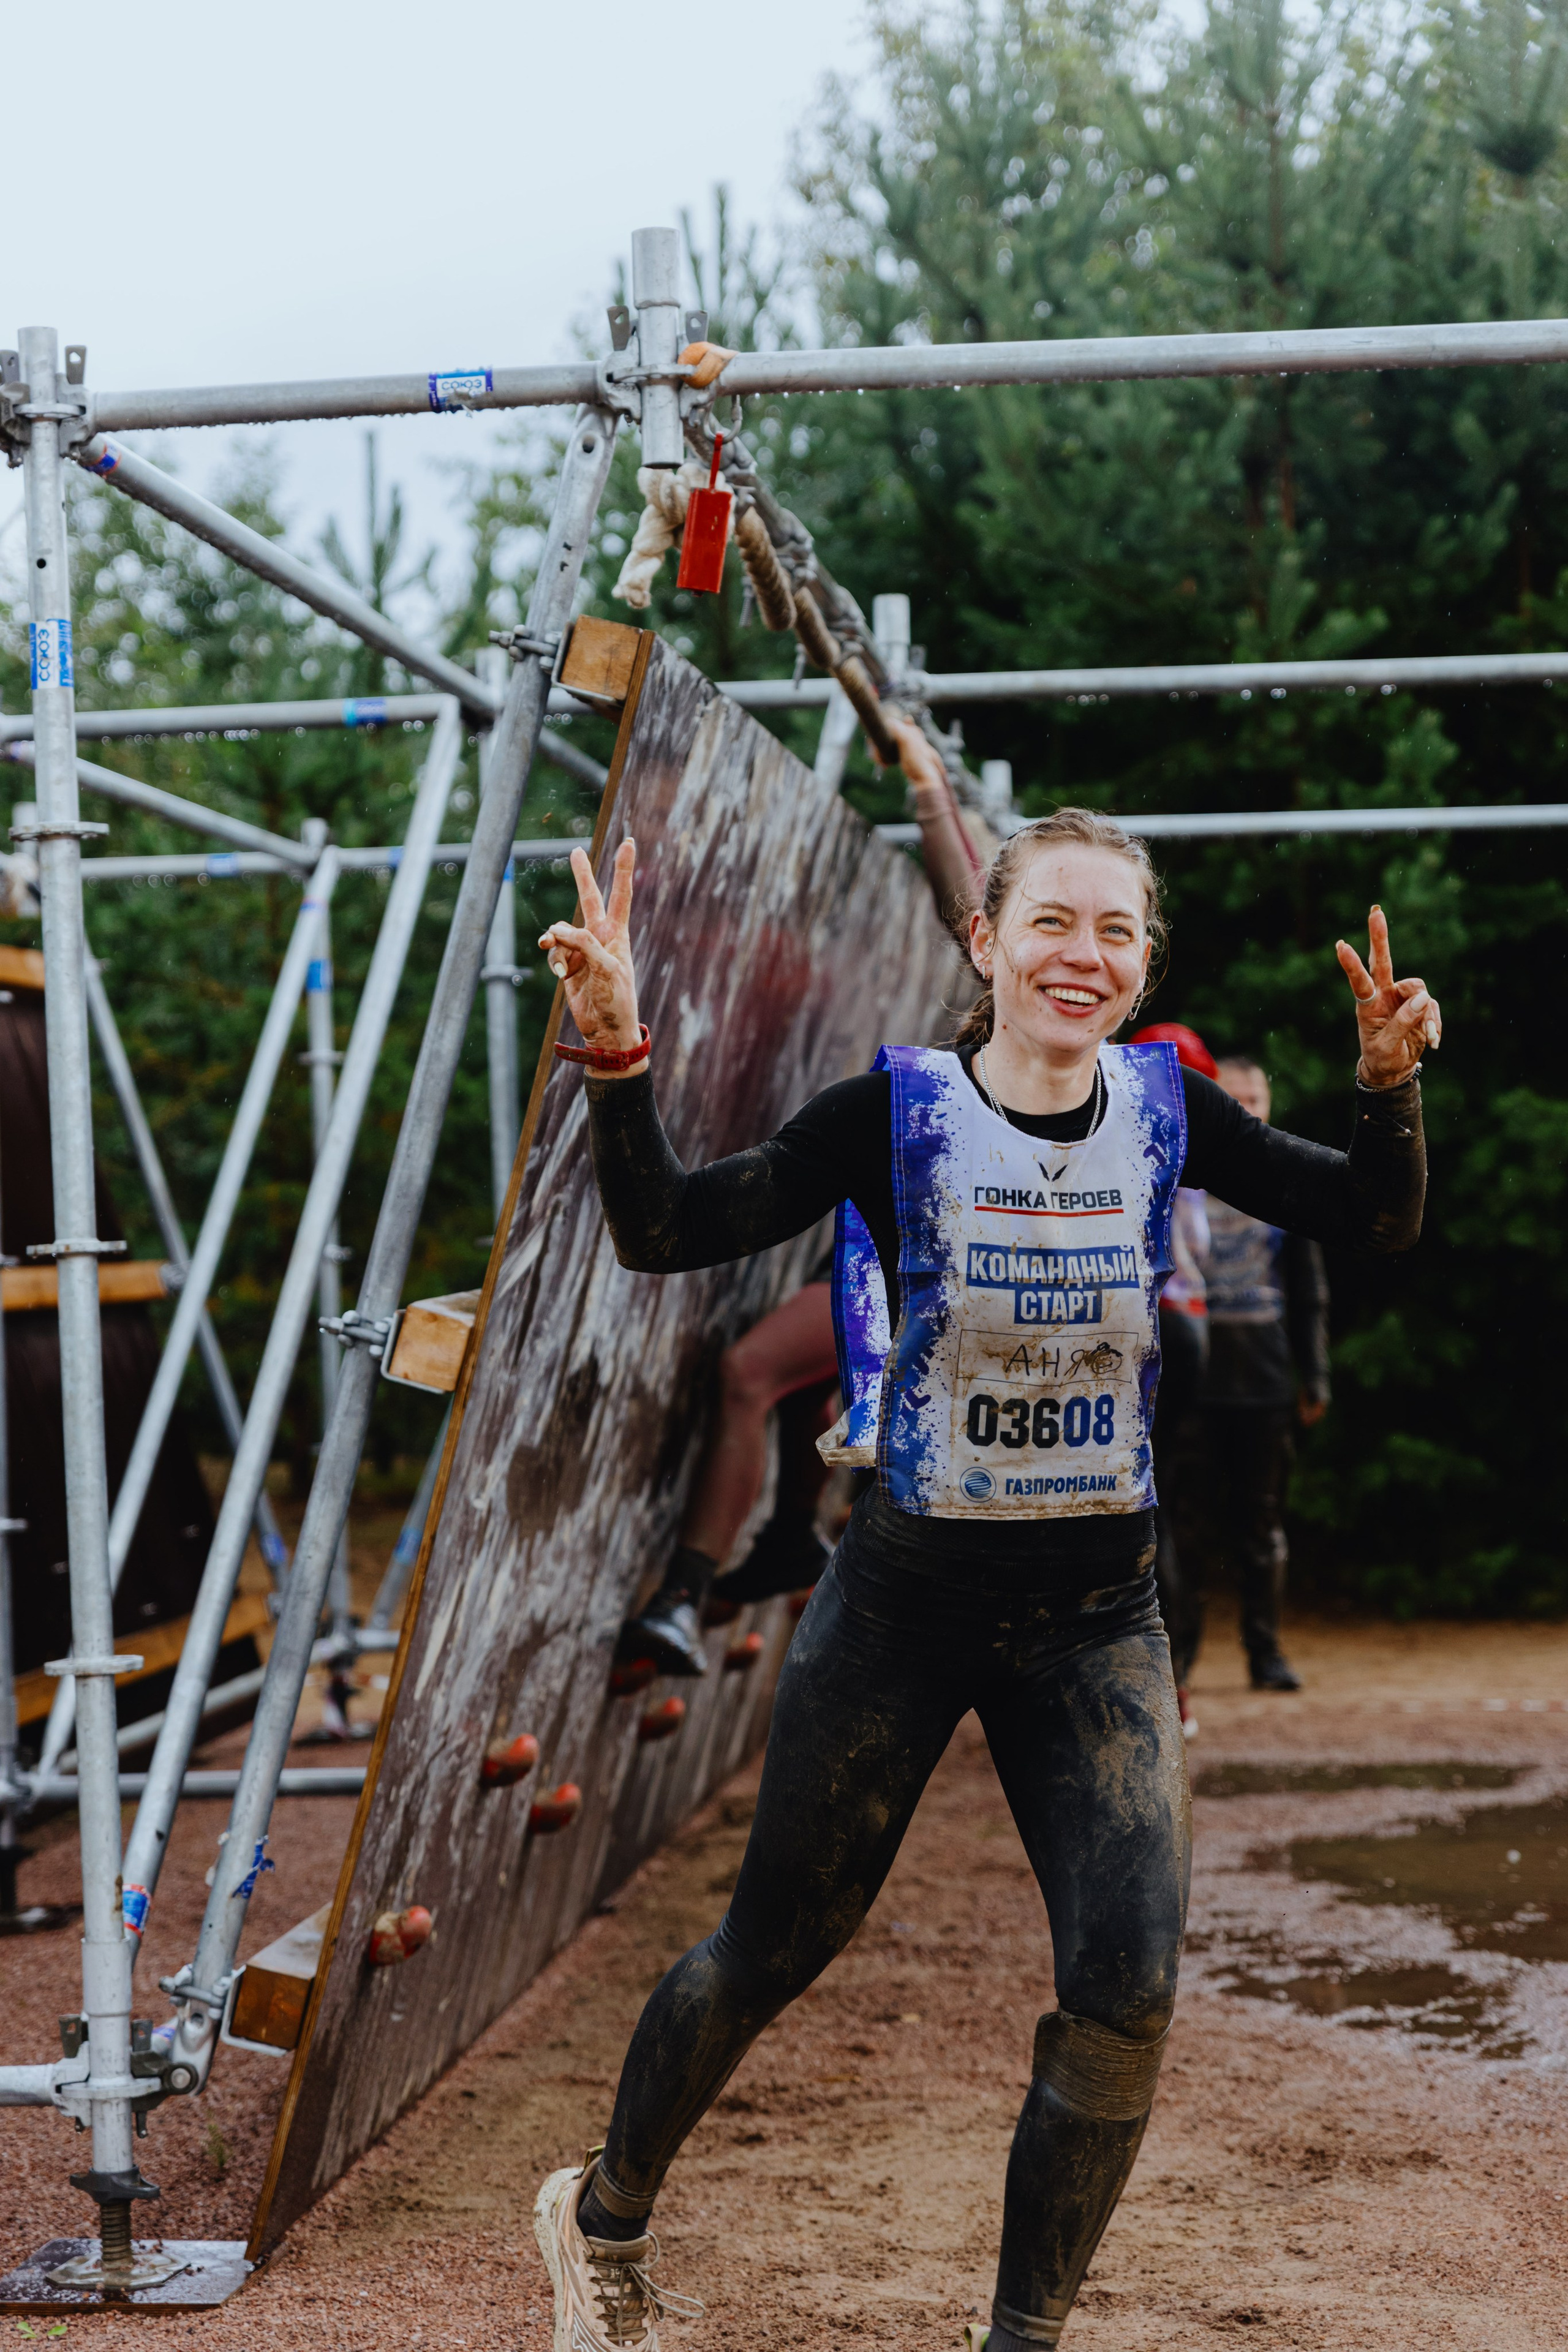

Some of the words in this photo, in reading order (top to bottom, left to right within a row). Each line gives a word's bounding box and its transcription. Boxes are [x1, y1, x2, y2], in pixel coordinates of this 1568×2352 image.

[442, 379, 483, 391] СОЮЗ
[38, 628, 50, 682] СОЮЗ
[974, 1186, 1047, 1209] ГОНКА
[1050, 1189, 1123, 1210] ГЕРОЕВ
[970, 1245, 1136, 1289] КОМАНДНЫЙ
[1020, 1290, 1098, 1321] СТАРТ
[1005, 1344, 1085, 1378] АНЯ
[966, 1393, 1115, 1449] 03608
[1005, 1475, 1118, 1496] ГАЗПРОМБАНК
